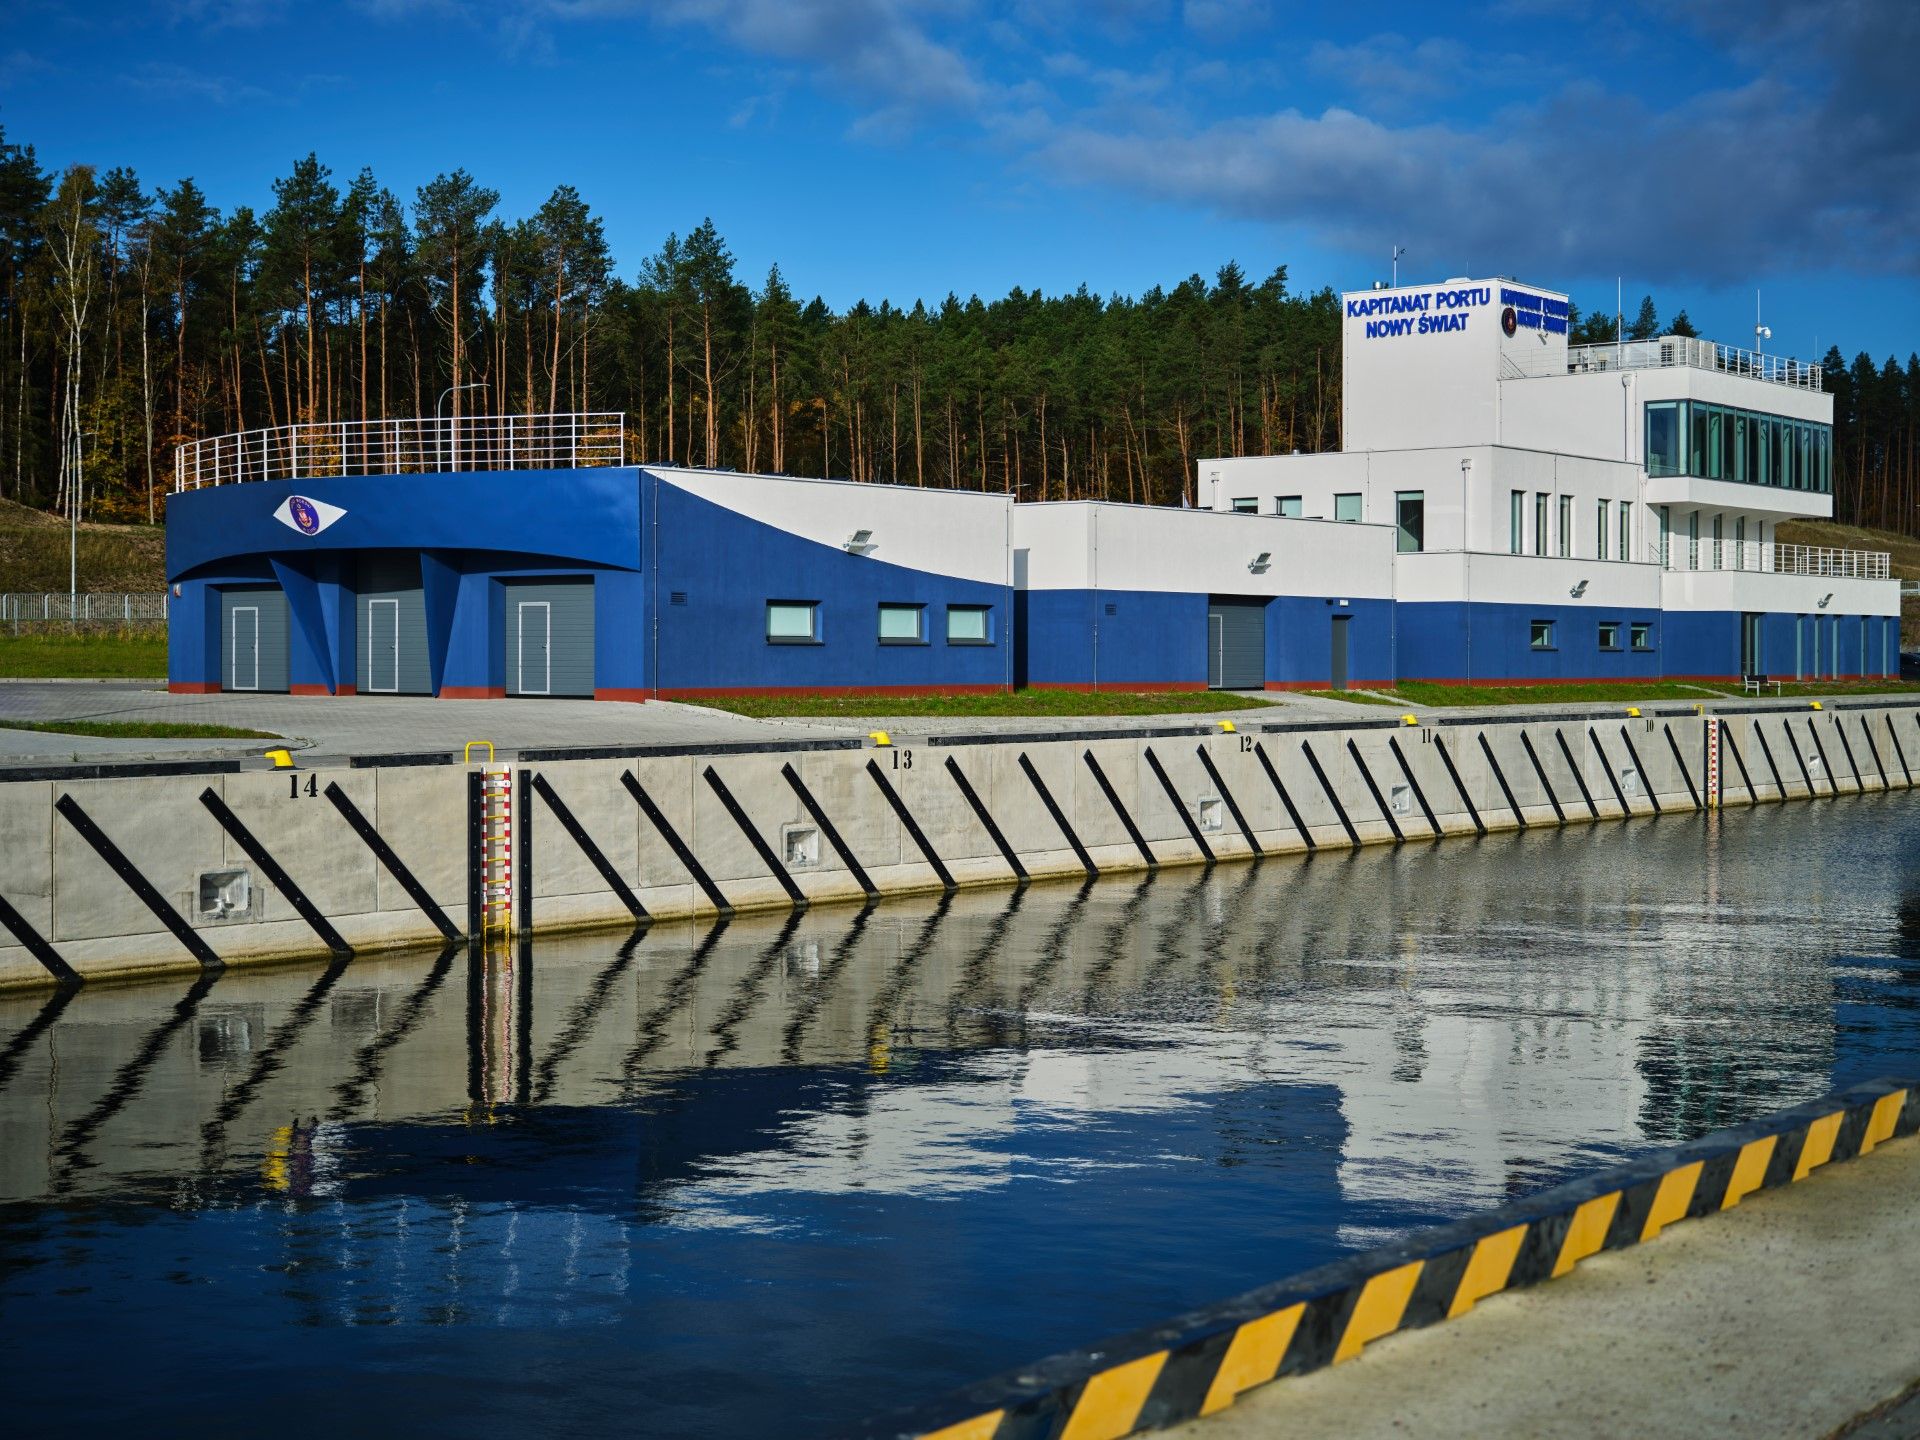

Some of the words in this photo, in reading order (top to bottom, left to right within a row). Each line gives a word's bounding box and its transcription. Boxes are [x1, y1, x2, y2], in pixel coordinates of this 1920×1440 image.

[1347, 293, 1432, 317] KAPITANAT
[1436, 287, 1490, 309] PORTU
[1366, 317, 1415, 339] NOWY
[1418, 312, 1469, 334] ŚWIAT
[1422, 728, 1431, 743] 11
[1646, 719, 1654, 732] 10
[1240, 735, 1252, 752] 12
[893, 749, 912, 769] 13
[289, 773, 318, 798] 14
